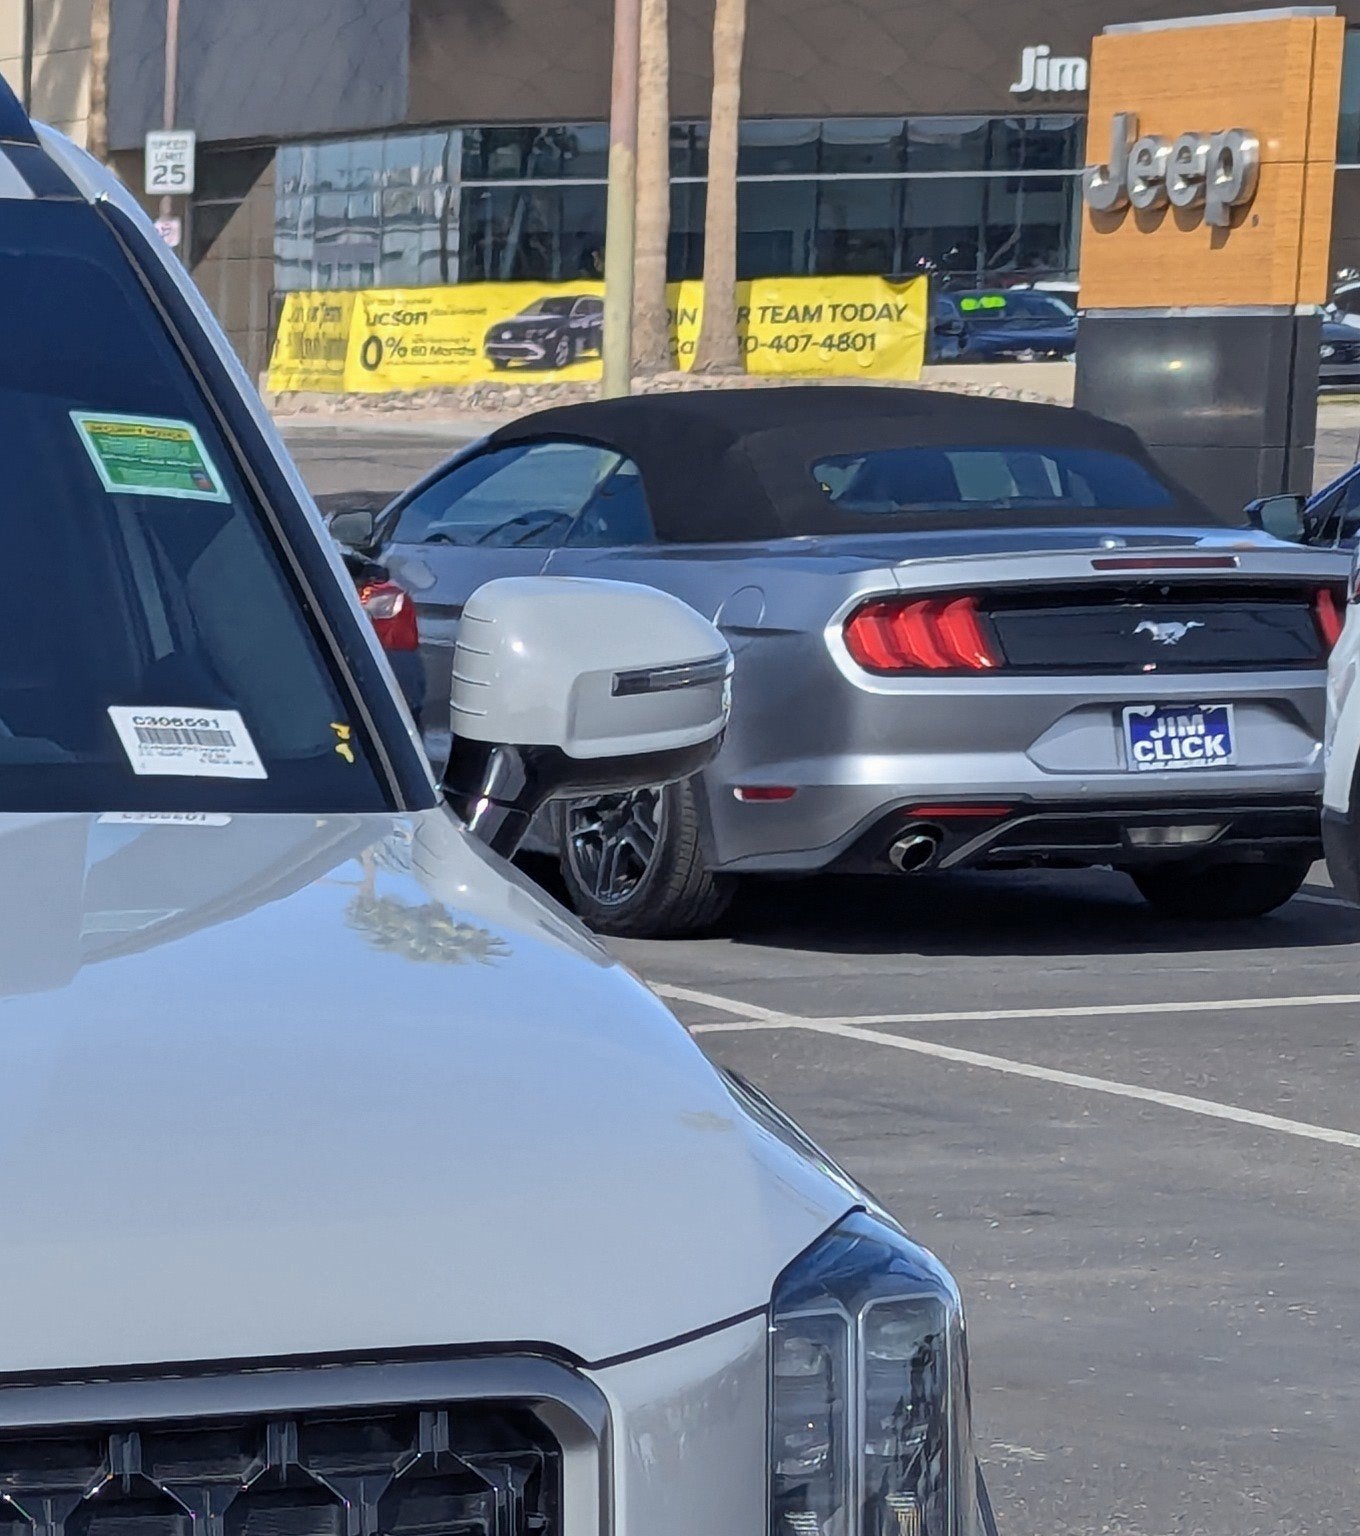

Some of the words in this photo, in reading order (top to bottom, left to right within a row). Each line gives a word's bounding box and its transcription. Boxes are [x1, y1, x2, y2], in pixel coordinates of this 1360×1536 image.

[1009, 44, 1087, 93] Jim
[152, 164, 186, 185] 25
[1082, 112, 1261, 226] Jeep
[759, 304, 821, 324] TEAM
[830, 302, 908, 323] TODAY
[738, 332, 876, 354] 0-407-4801
[1150, 714, 1205, 738] JIM
[1133, 734, 1226, 761] CLICK
